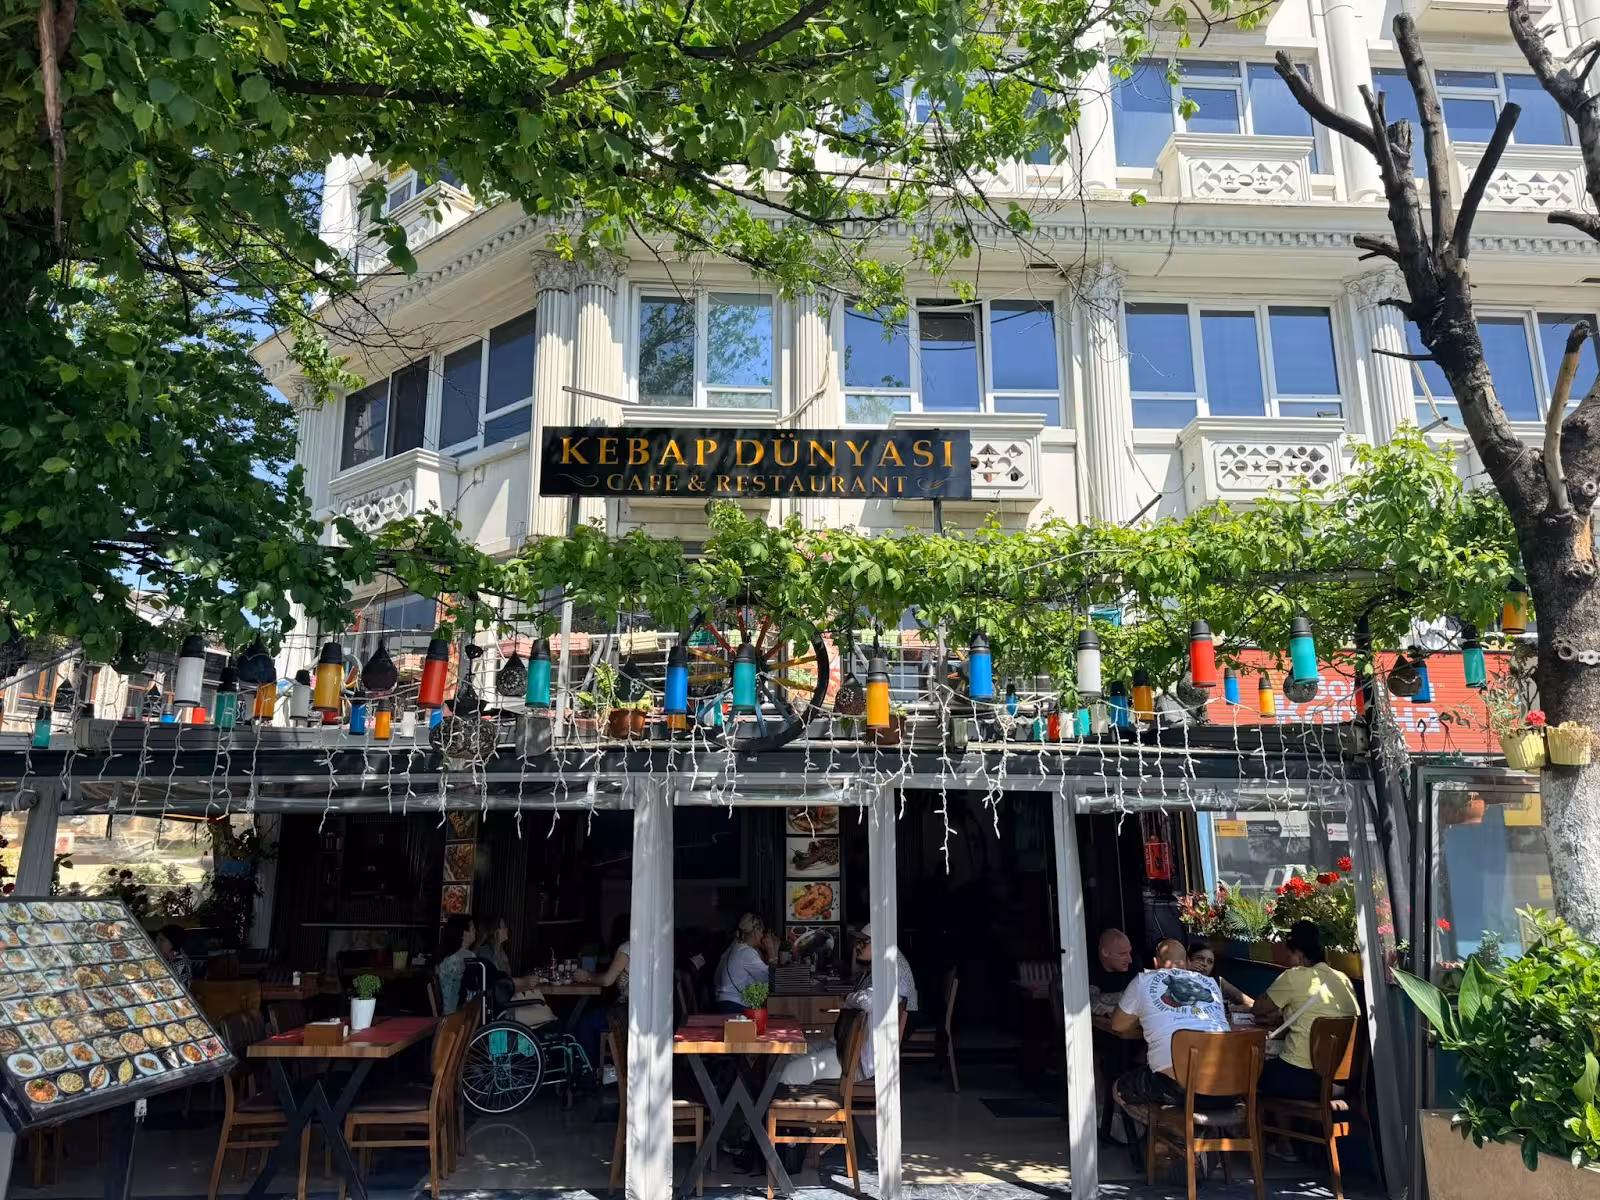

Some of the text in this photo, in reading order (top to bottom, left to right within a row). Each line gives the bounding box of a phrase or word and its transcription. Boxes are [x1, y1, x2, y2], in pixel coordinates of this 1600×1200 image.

[560, 432, 953, 468] KEBAP DÜNYASI
[606, 473, 908, 493] CAFE & RESTAURANT
